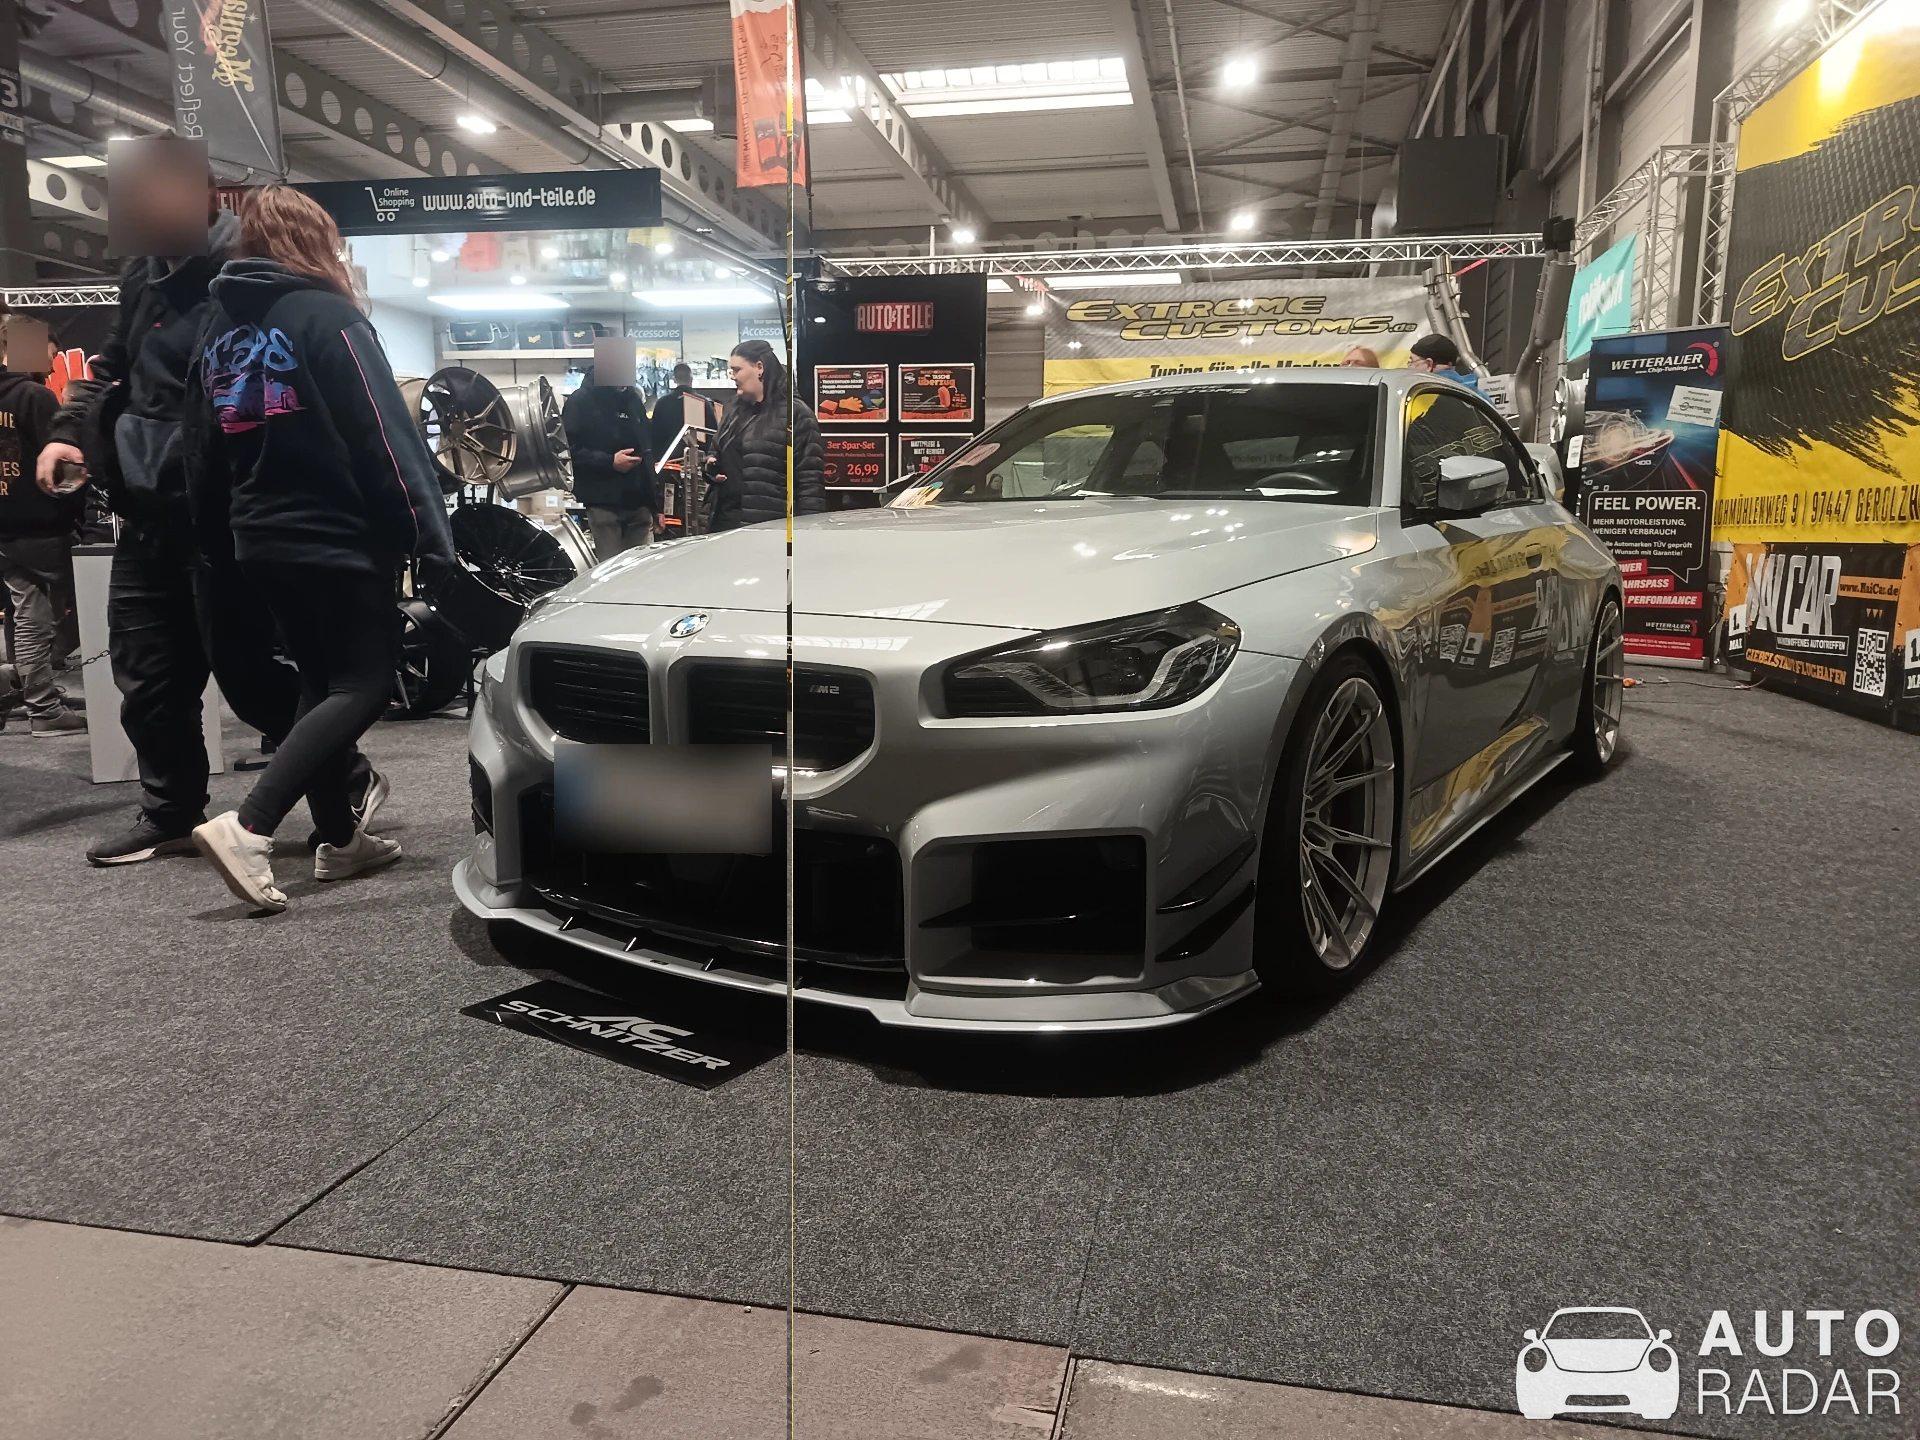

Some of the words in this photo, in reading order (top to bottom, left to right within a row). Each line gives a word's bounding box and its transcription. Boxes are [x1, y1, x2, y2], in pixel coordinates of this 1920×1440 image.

[383, 187, 409, 198] Online
[422, 186, 596, 212] www.auto-und-teile.de
[378, 195, 415, 209] Shopping
[1731, 184, 1920, 336] EXTR
[1066, 296, 1326, 322] EXTREME
[626, 327, 680, 339] Accessoires
[1119, 315, 1417, 341] CUSTOMS.de
[1611, 353, 1703, 371] WETTERAUER
[827, 441, 841, 449] 3er
[842, 440, 876, 450] Spar-Set
[847, 464, 879, 476] 26,99
[1594, 497, 1630, 511] FEEL
[1635, 496, 1701, 511] POWER.
[1790, 493, 1799, 525] 9
[1811, 489, 1852, 523] 97447
[1855, 484, 1920, 523] GEROLZH
[1593, 518, 1615, 526] MEHR
[1616, 518, 1686, 527] MOTORLEISTUNG,
[1592, 528, 1627, 536] WENIGER
[1629, 528, 1677, 536] VERBRAUCH
[1653, 540, 1666, 548] TÜV
[1667, 541, 1693, 549] geprüft
[1622, 578, 1670, 590] AHRSPASS
[1627, 595, 1698, 606] PERFORMANCE
[1645, 621, 1691, 630] WETTERAUER
[1729, 638, 1743, 651] MAI
[1796, 658, 1847, 686] FLUGHAFEN
[499, 1000, 731, 1070] SCHNITZER
